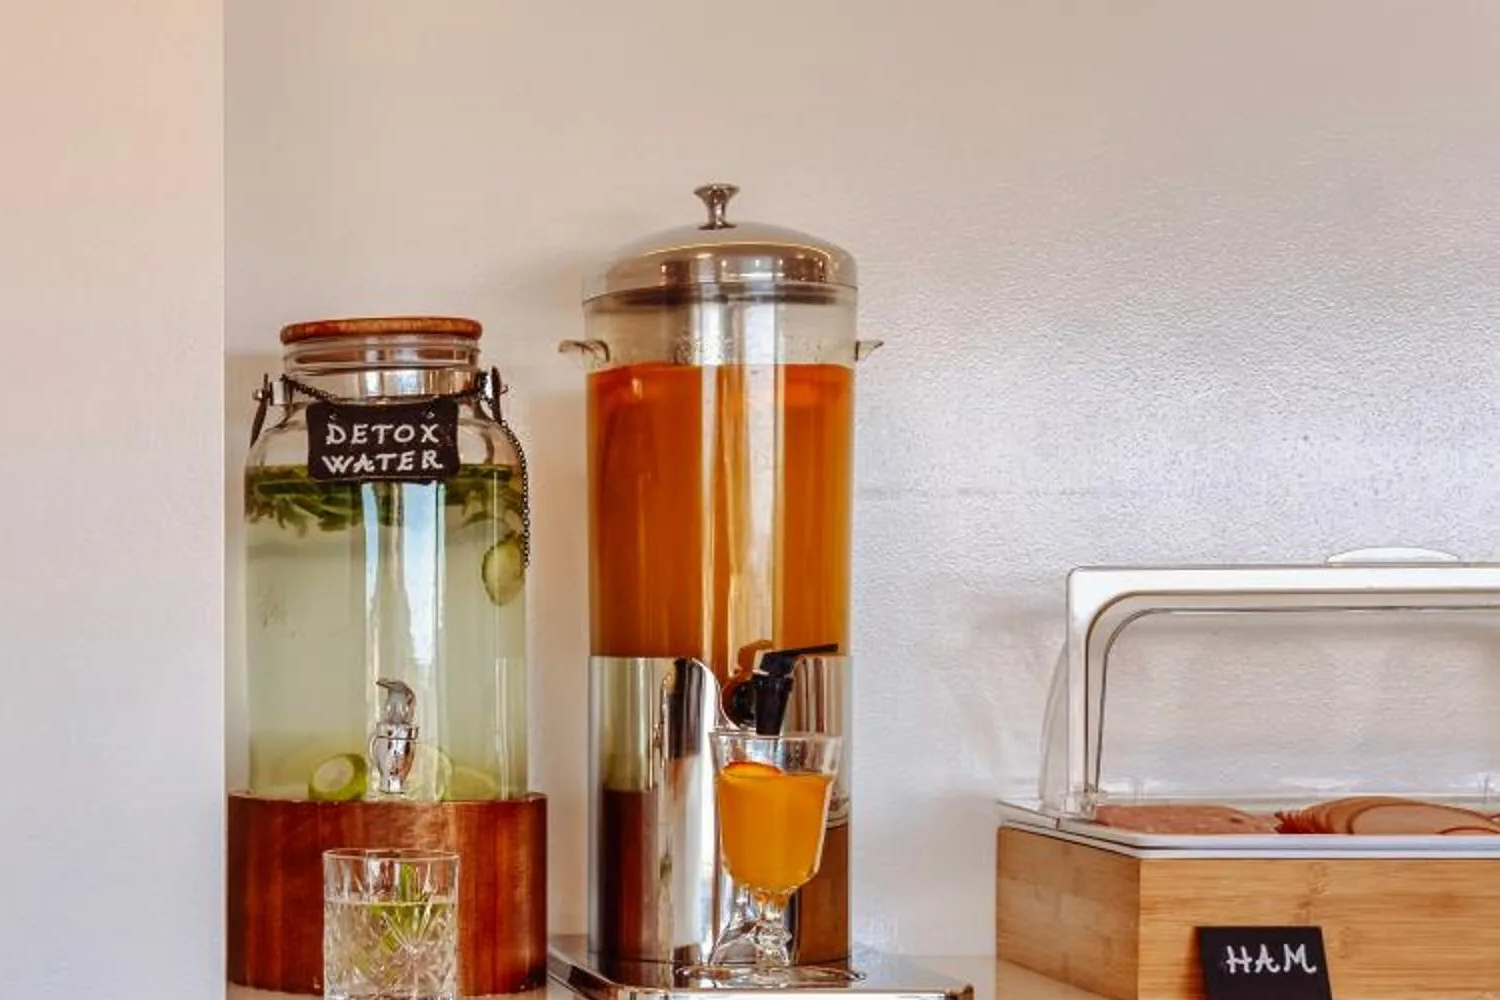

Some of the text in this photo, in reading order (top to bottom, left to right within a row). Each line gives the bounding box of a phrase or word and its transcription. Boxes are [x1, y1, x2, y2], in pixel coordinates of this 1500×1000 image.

[326, 423, 439, 445] DETOX
[321, 450, 443, 474] WATER
[1226, 943, 1317, 973] HAM
